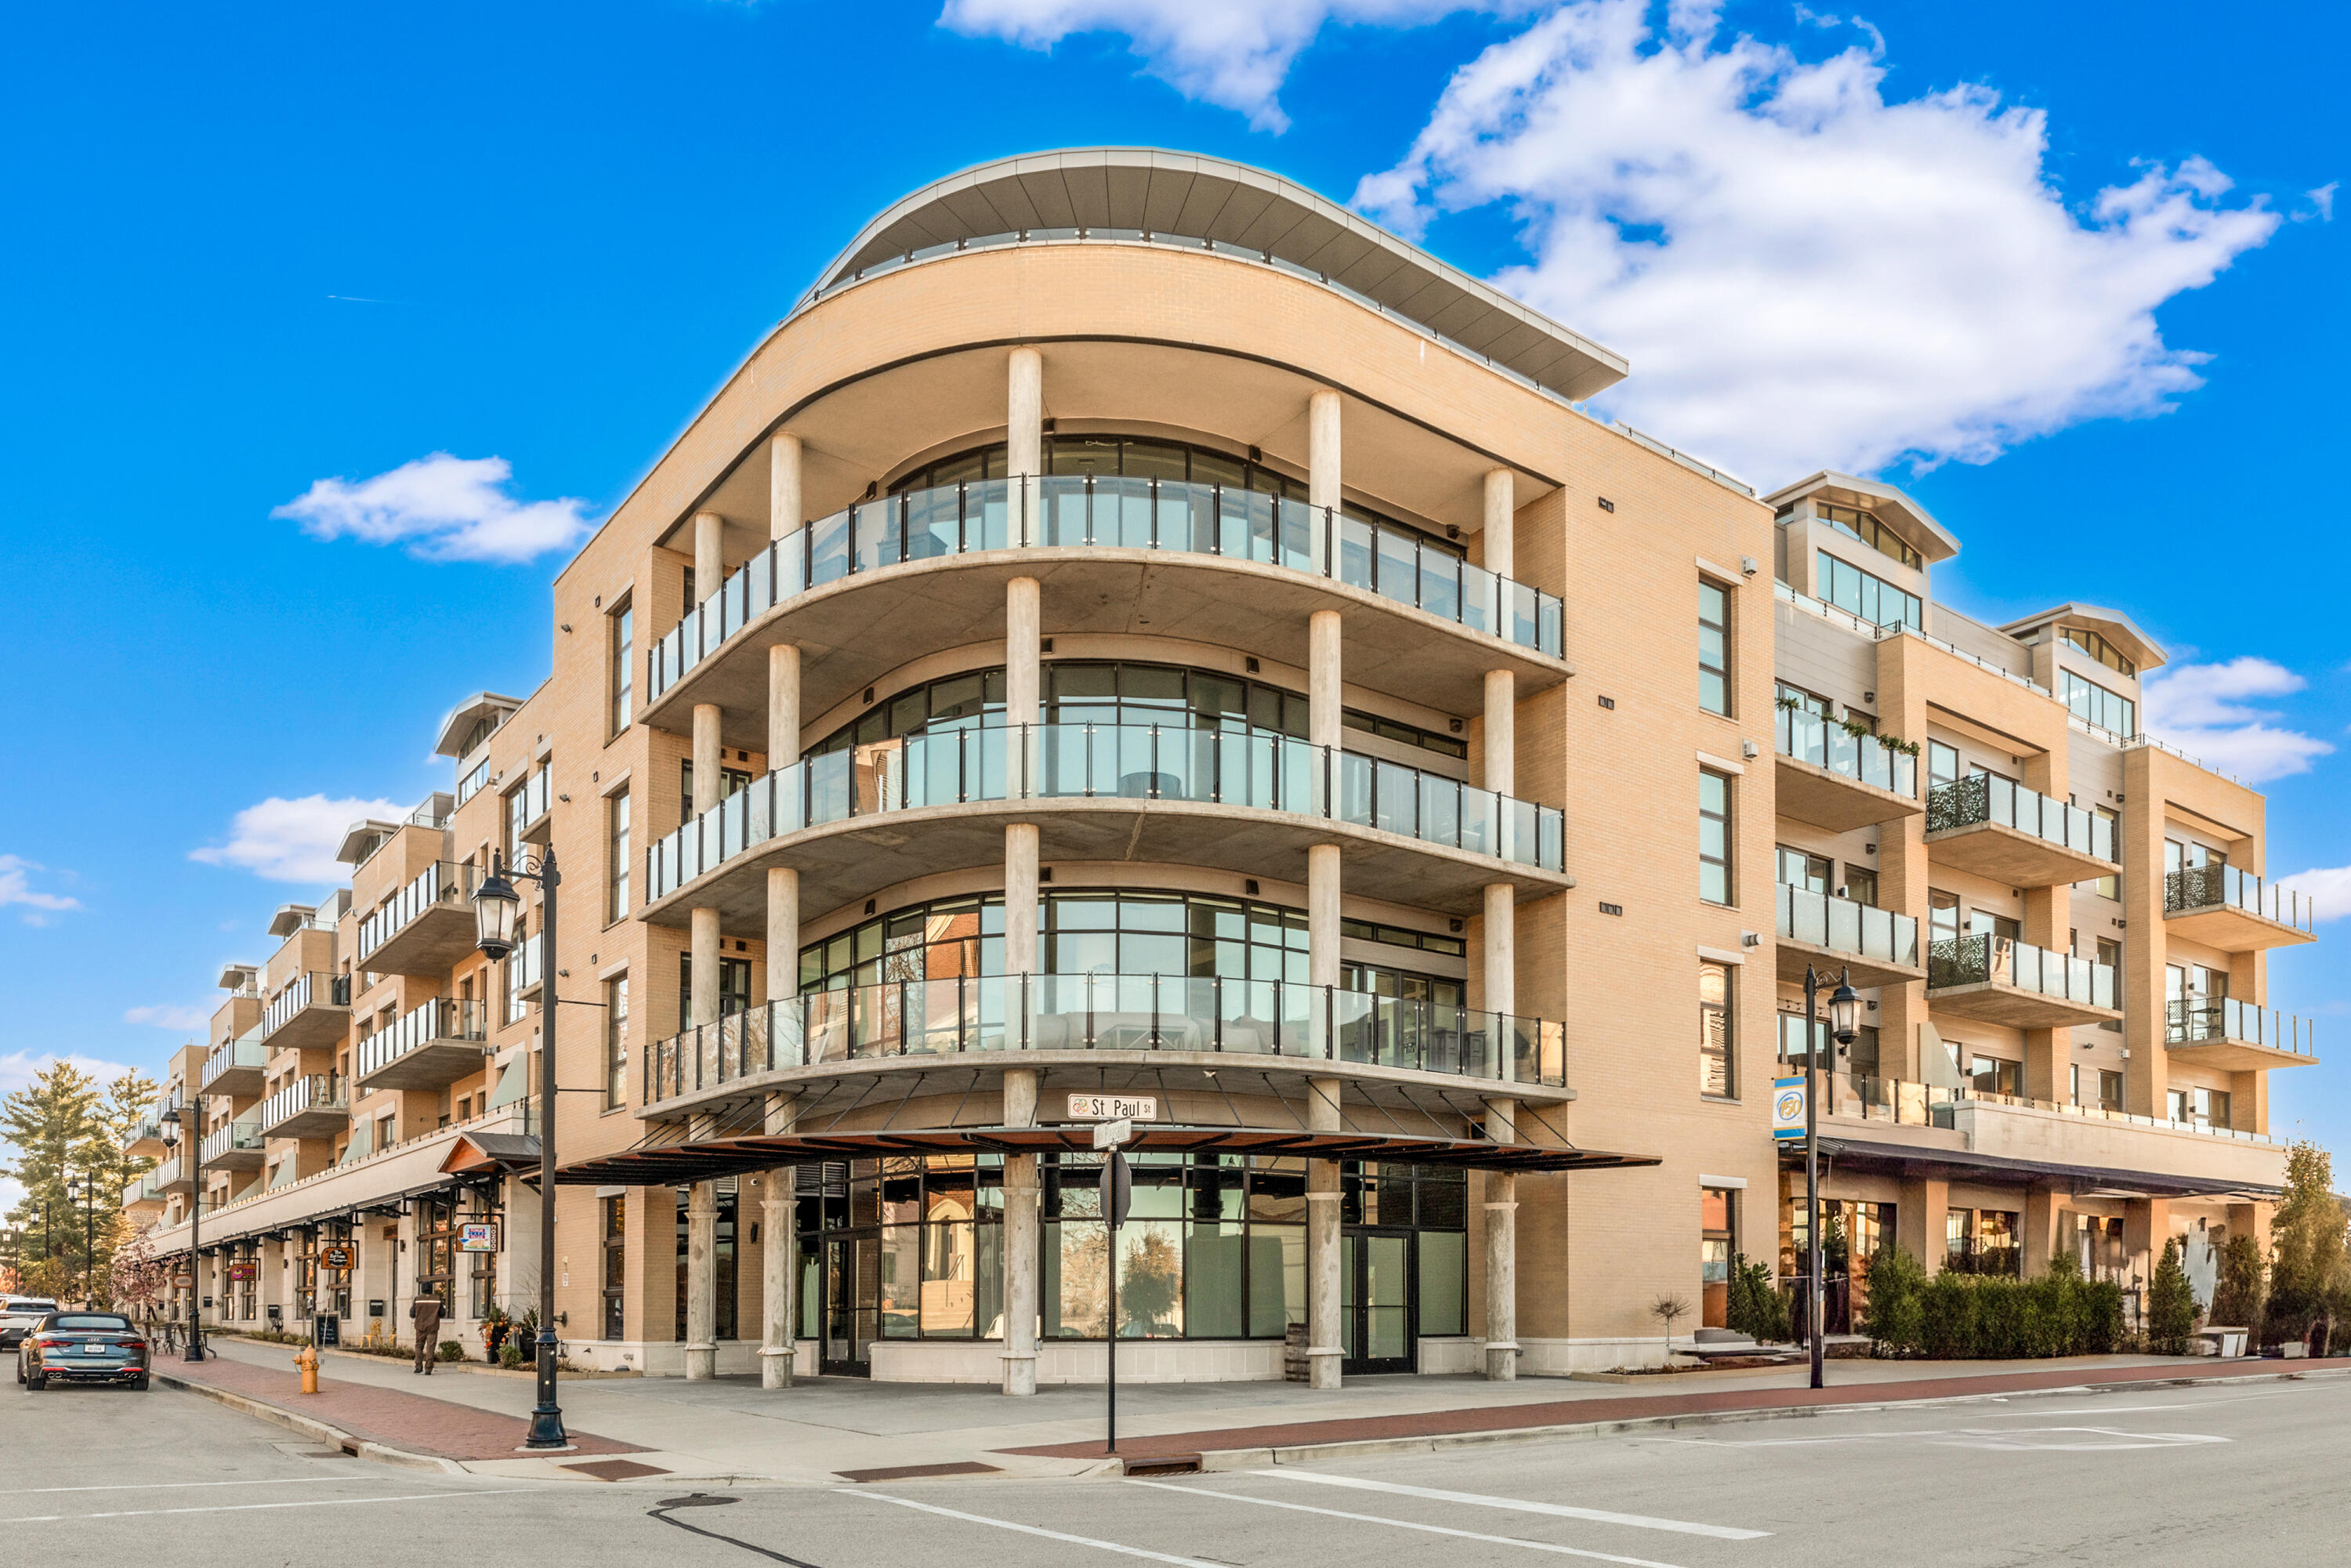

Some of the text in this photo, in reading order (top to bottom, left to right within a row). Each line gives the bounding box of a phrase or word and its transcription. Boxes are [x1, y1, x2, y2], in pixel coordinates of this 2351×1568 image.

[1092, 1099, 1150, 1117] St Paul St
[1780, 1099, 1801, 1117] 150
